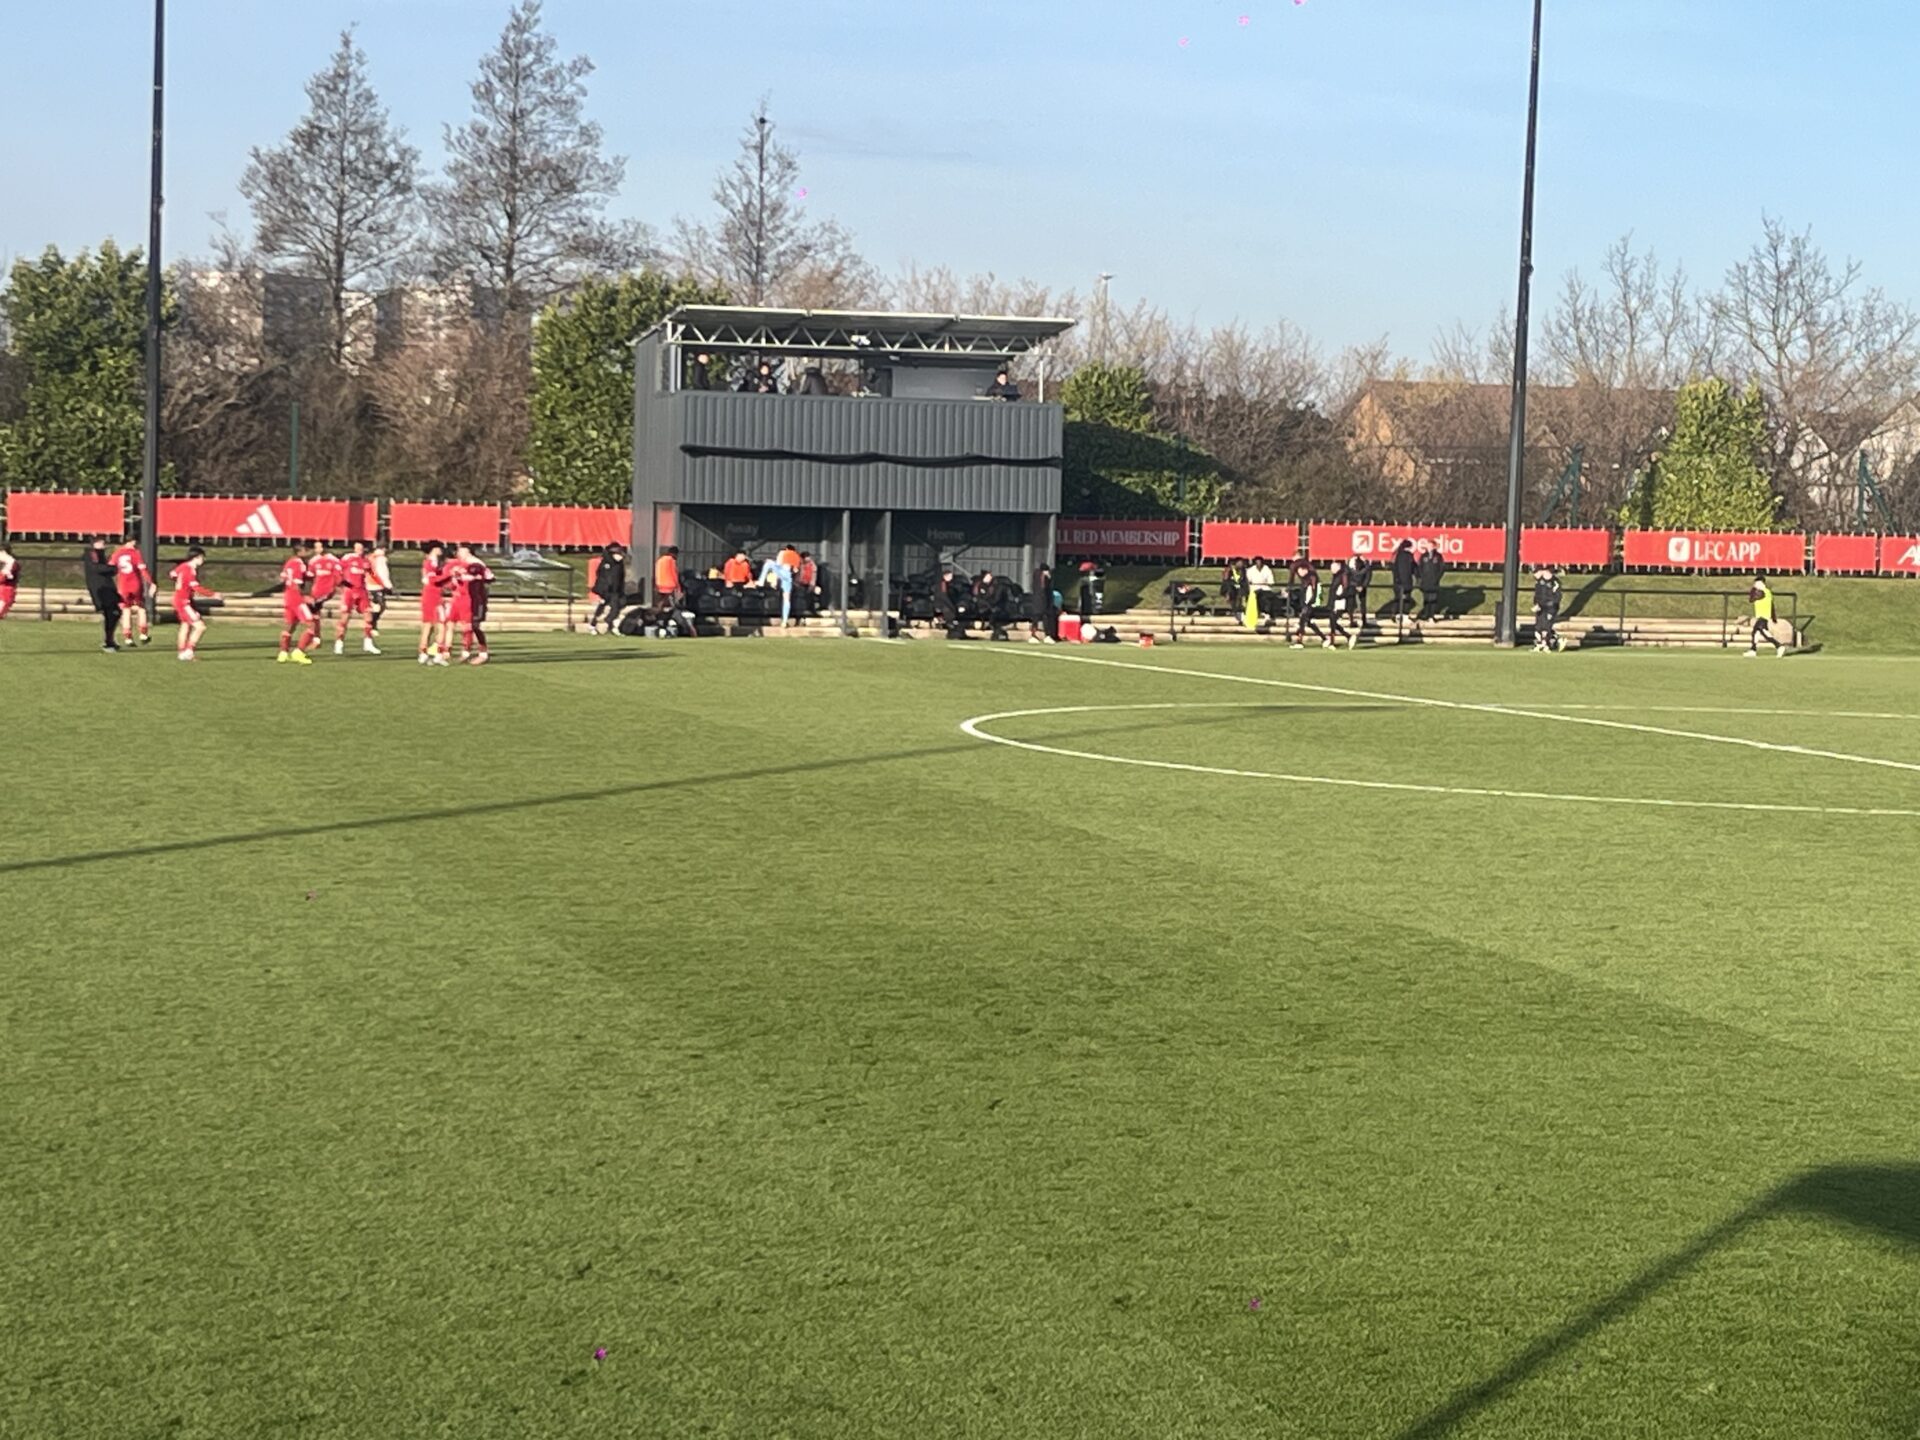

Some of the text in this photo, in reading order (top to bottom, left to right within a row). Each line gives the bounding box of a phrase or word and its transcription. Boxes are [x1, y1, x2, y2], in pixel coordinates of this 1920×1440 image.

[927, 527, 965, 541] Home
[1057, 529, 1180, 548] LL RED MEMBERSHIP
[1694, 540, 1761, 562] LFC APP
[118, 554, 133, 574] 5
